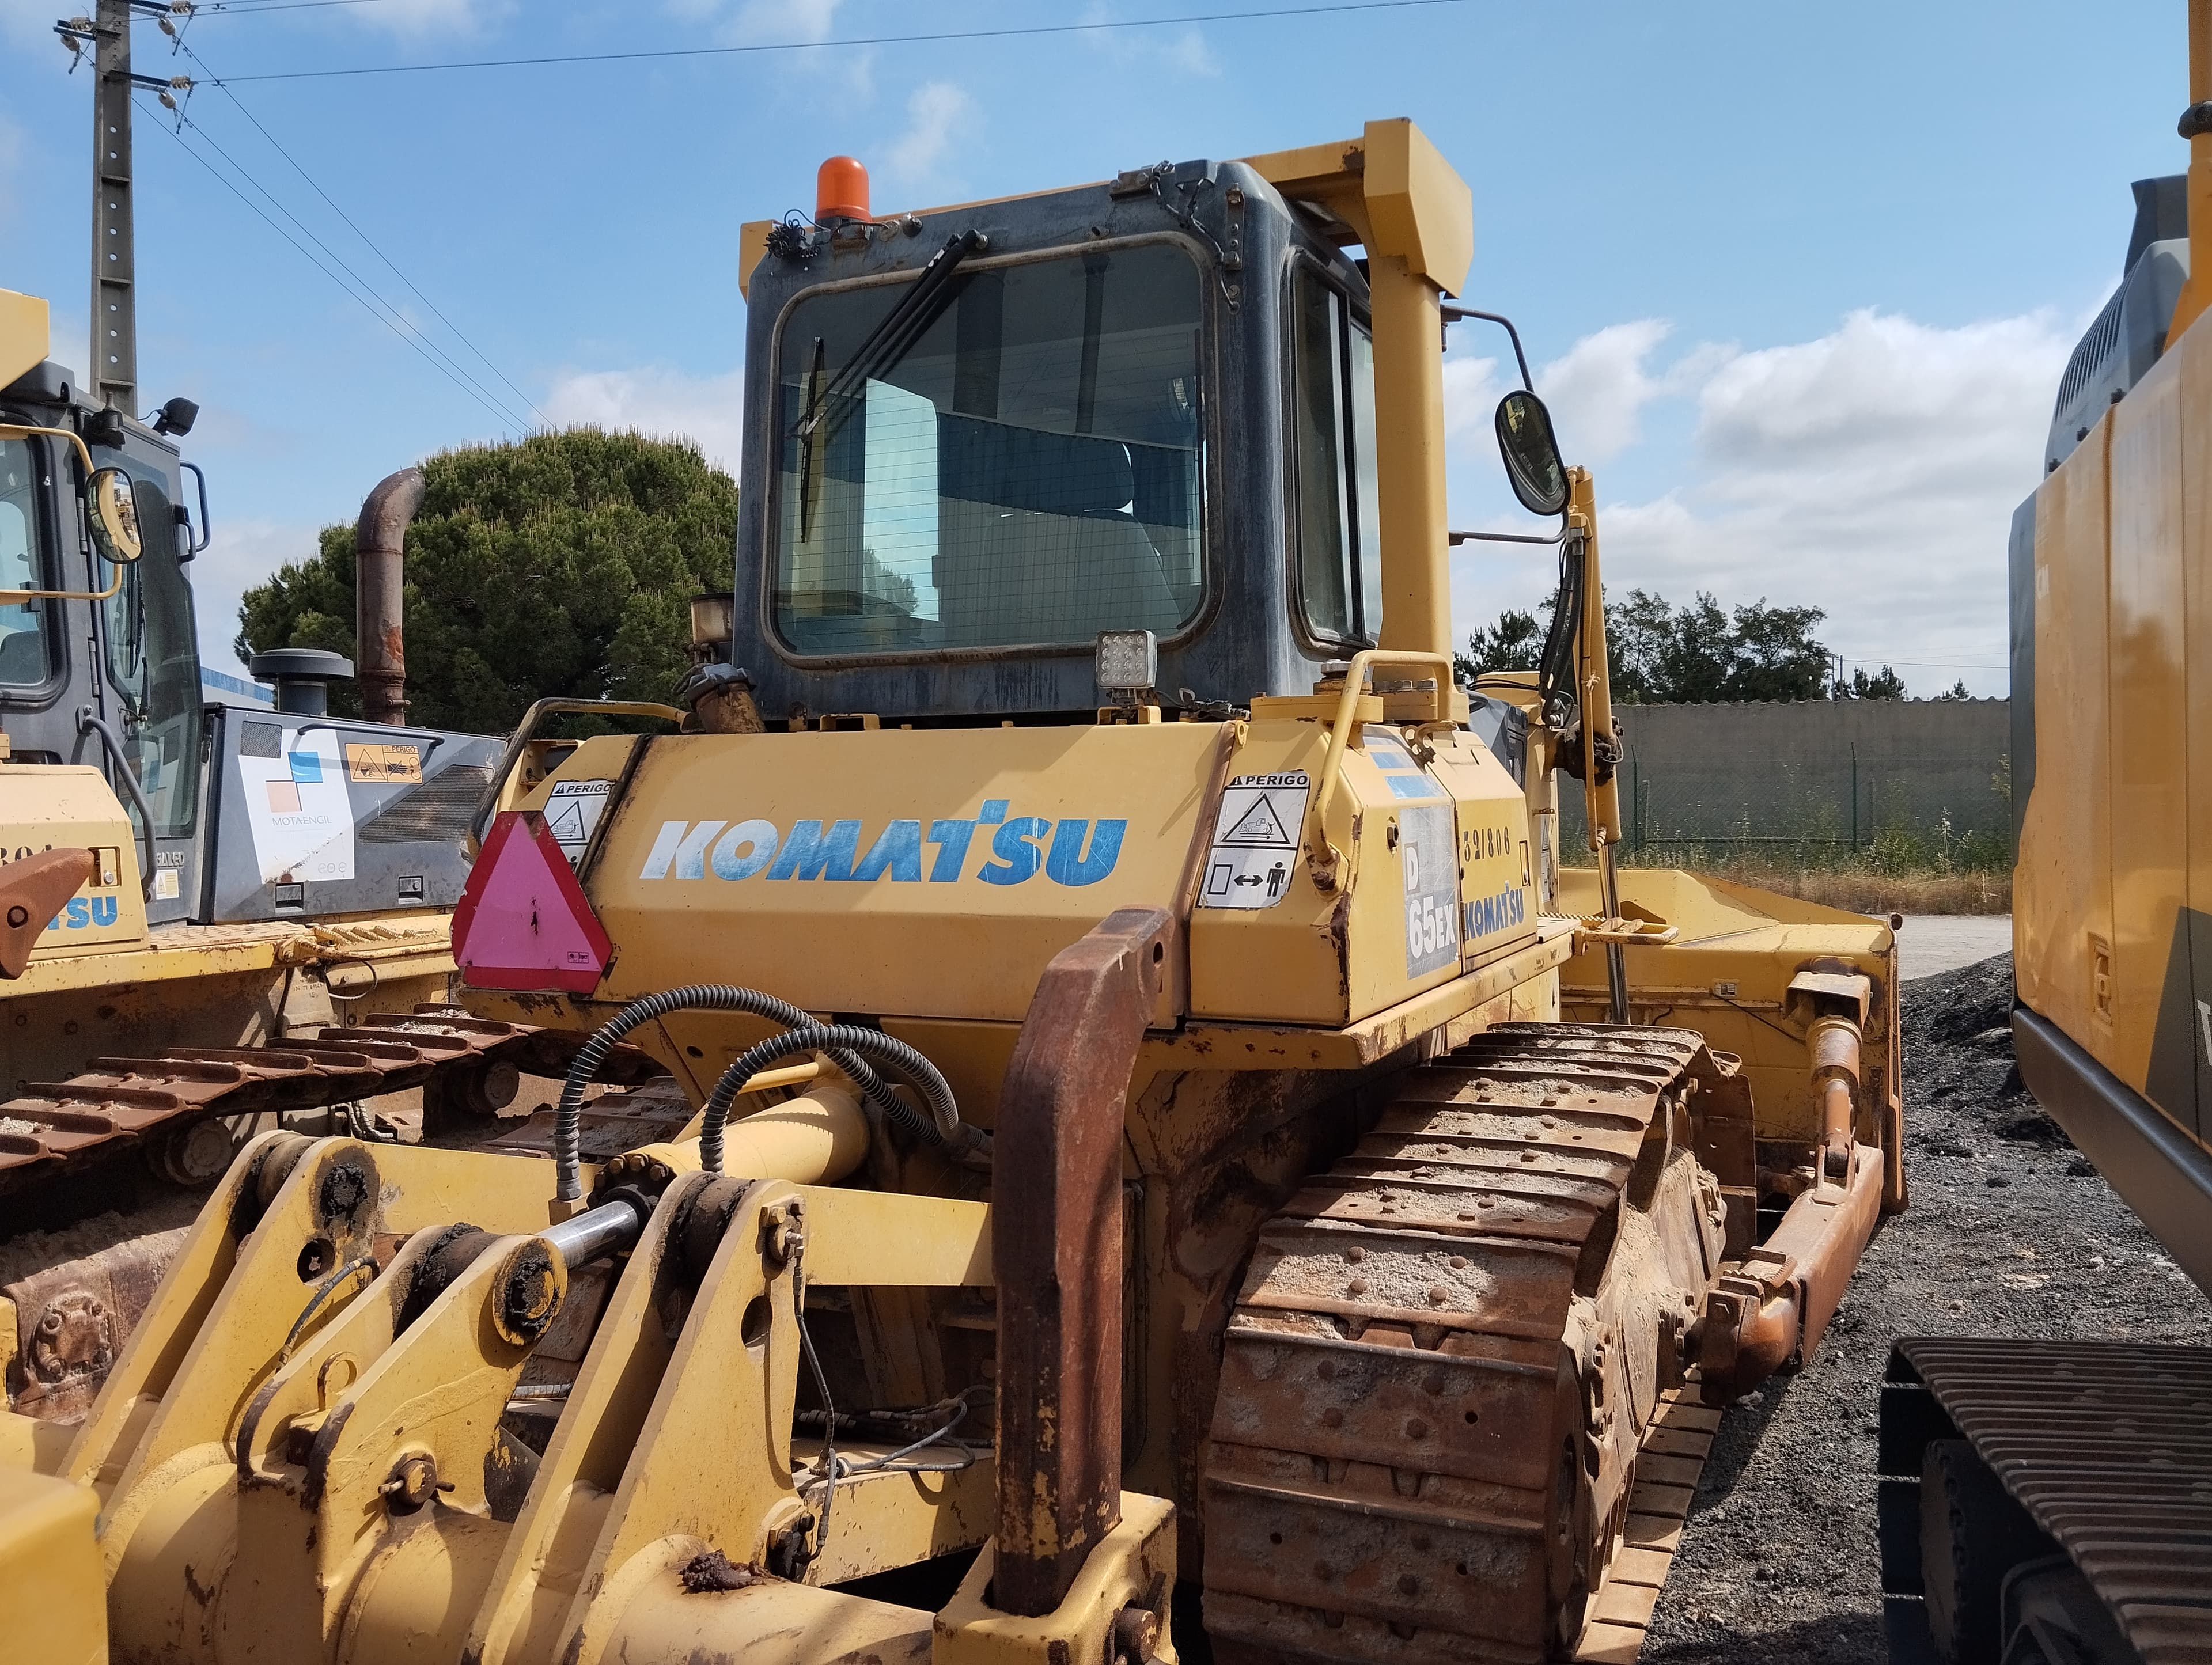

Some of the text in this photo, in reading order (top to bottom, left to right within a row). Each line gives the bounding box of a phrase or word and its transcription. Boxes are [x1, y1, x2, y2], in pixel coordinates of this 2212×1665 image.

[1245, 775, 1308, 786] PERIGO
[639, 799, 1128, 887] KOMATSU
[1406, 847, 1419, 891] D
[1409, 896, 1456, 959] 65EX
[1465, 880, 1524, 940] KOMATSU
